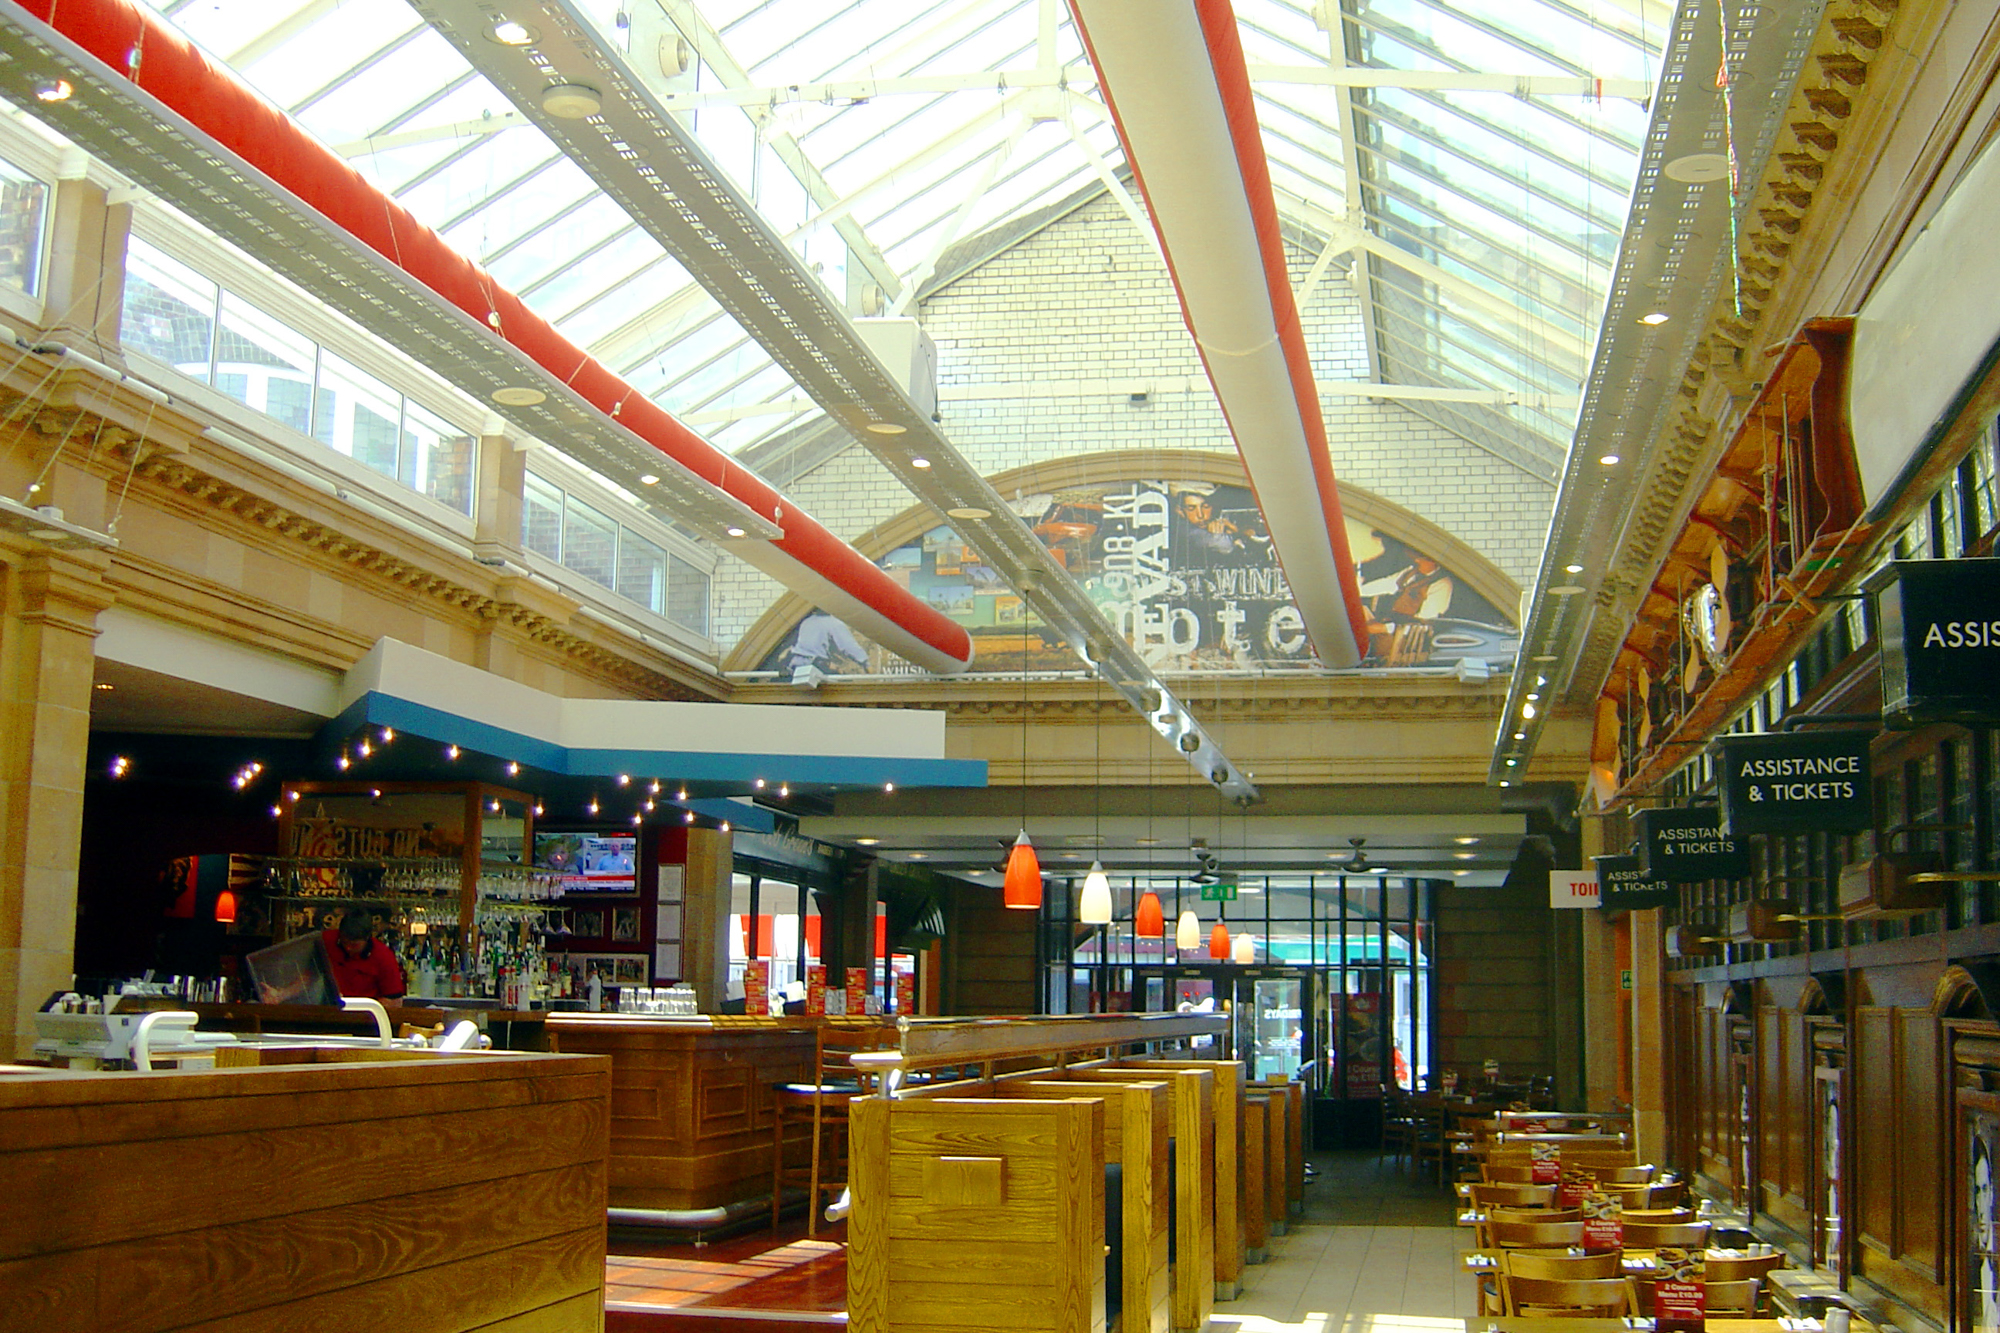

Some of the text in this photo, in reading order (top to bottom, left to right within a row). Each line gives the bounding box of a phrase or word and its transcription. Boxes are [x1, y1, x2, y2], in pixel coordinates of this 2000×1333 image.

[1740, 756, 1860, 777] ASSISTANCE
[1748, 781, 1854, 802] & TICKETS
[1664, 841, 1735, 855] & TICKETS
